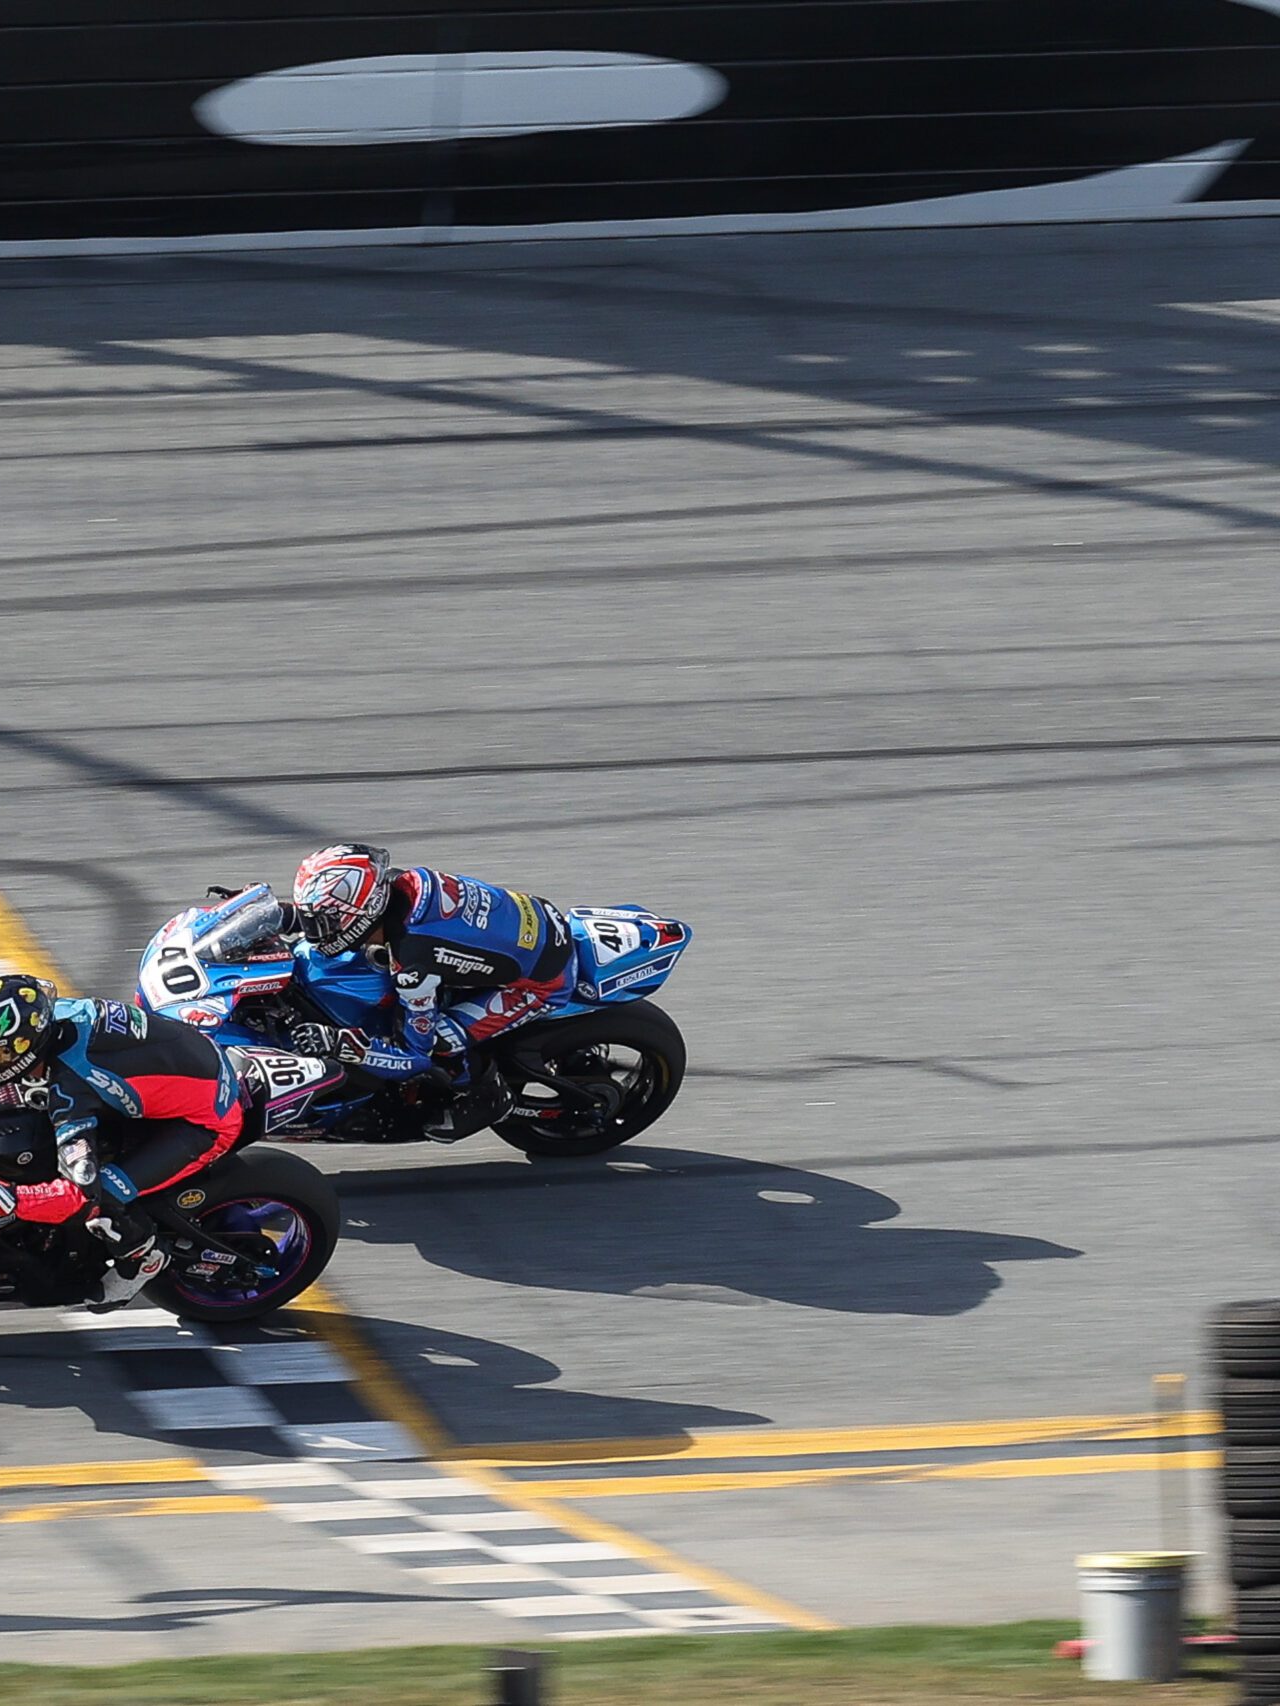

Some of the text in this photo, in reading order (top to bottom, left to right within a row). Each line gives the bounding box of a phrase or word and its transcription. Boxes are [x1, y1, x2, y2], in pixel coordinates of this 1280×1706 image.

[476, 887, 491, 930] SUZ
[594, 922, 623, 953] 40
[157, 947, 201, 995] 40
[264, 1058, 306, 1087] 96
